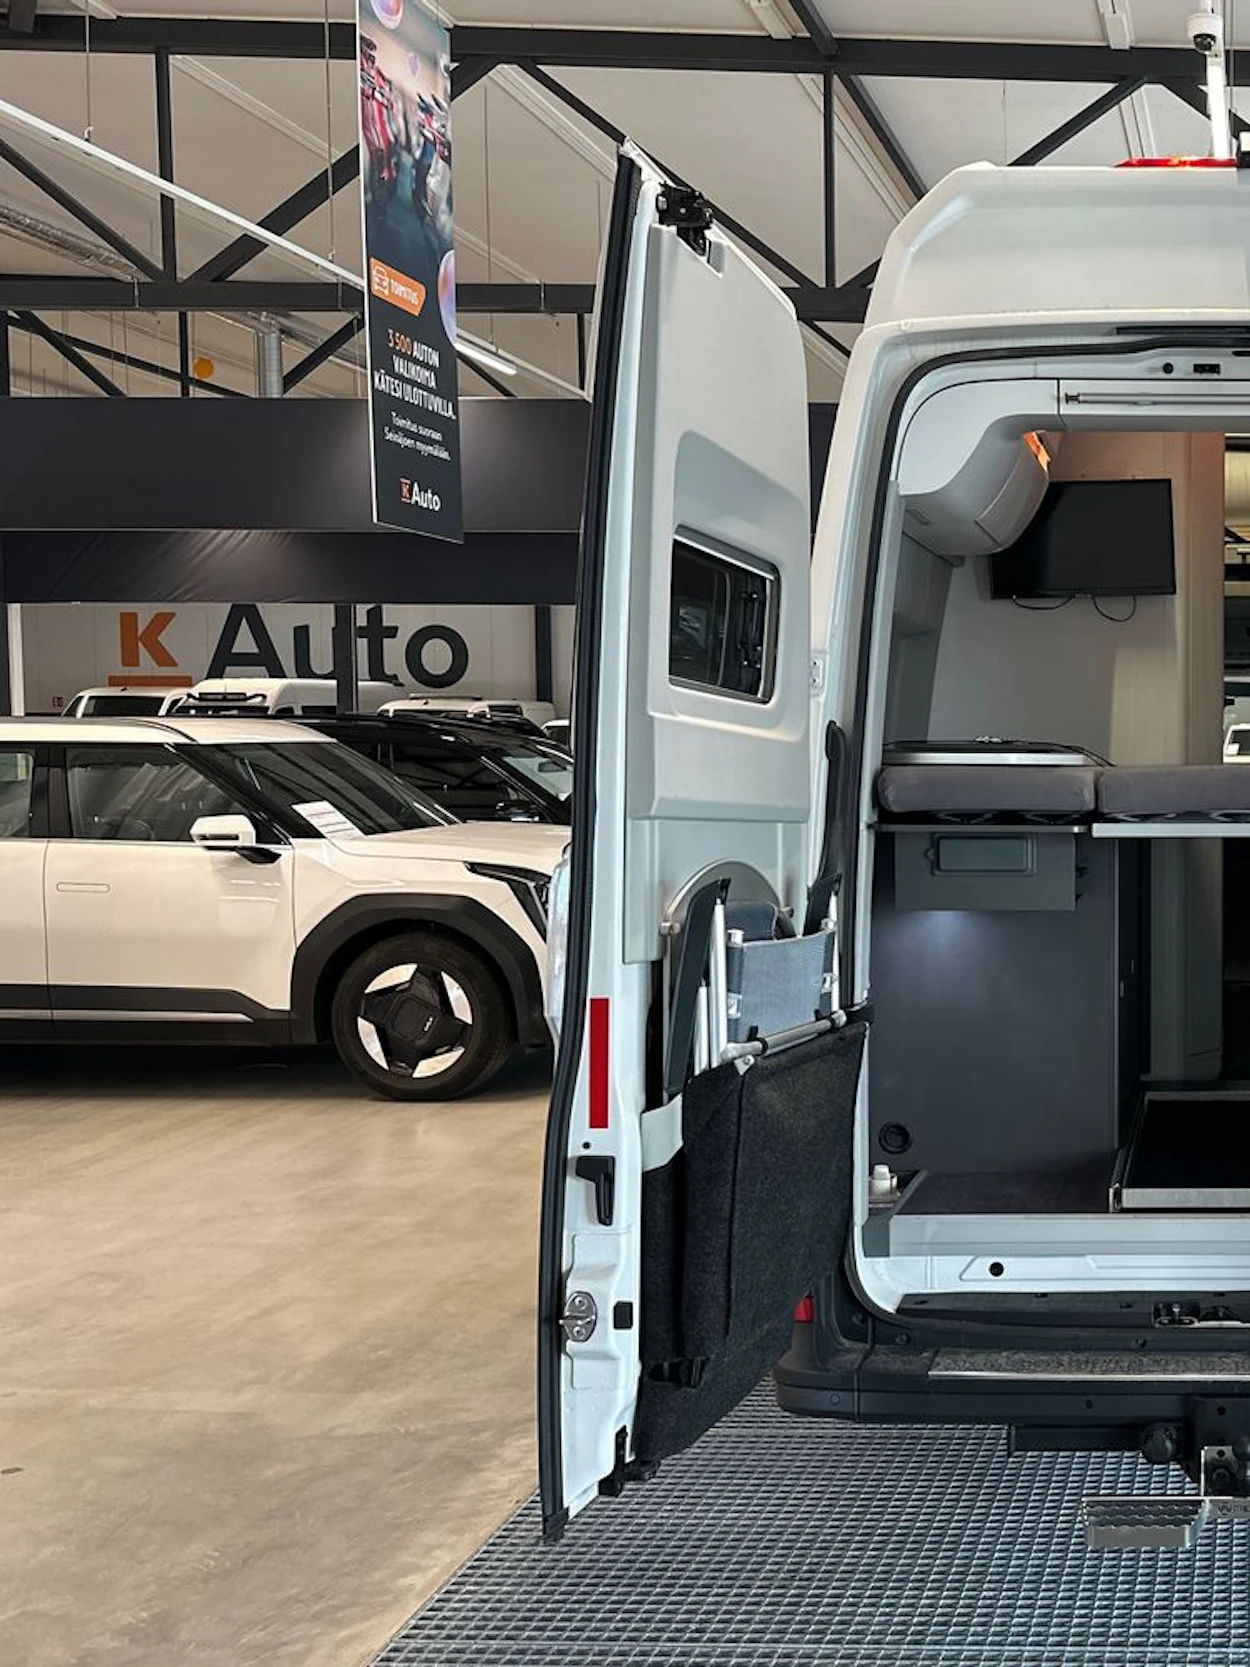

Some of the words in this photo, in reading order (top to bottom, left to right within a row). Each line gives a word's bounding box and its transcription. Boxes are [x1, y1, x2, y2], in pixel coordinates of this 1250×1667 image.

[413, 341, 439, 368] AUTON
[392, 354, 437, 390] VALIKOIMA
[374, 369, 402, 399] KÄTESI
[403, 386, 457, 420] ULOTTUVILLA.
[391, 411, 418, 433] Toimitus
[411, 481, 441, 511] Auto
[120, 612, 178, 667] K
[205, 603, 469, 688] Auto
